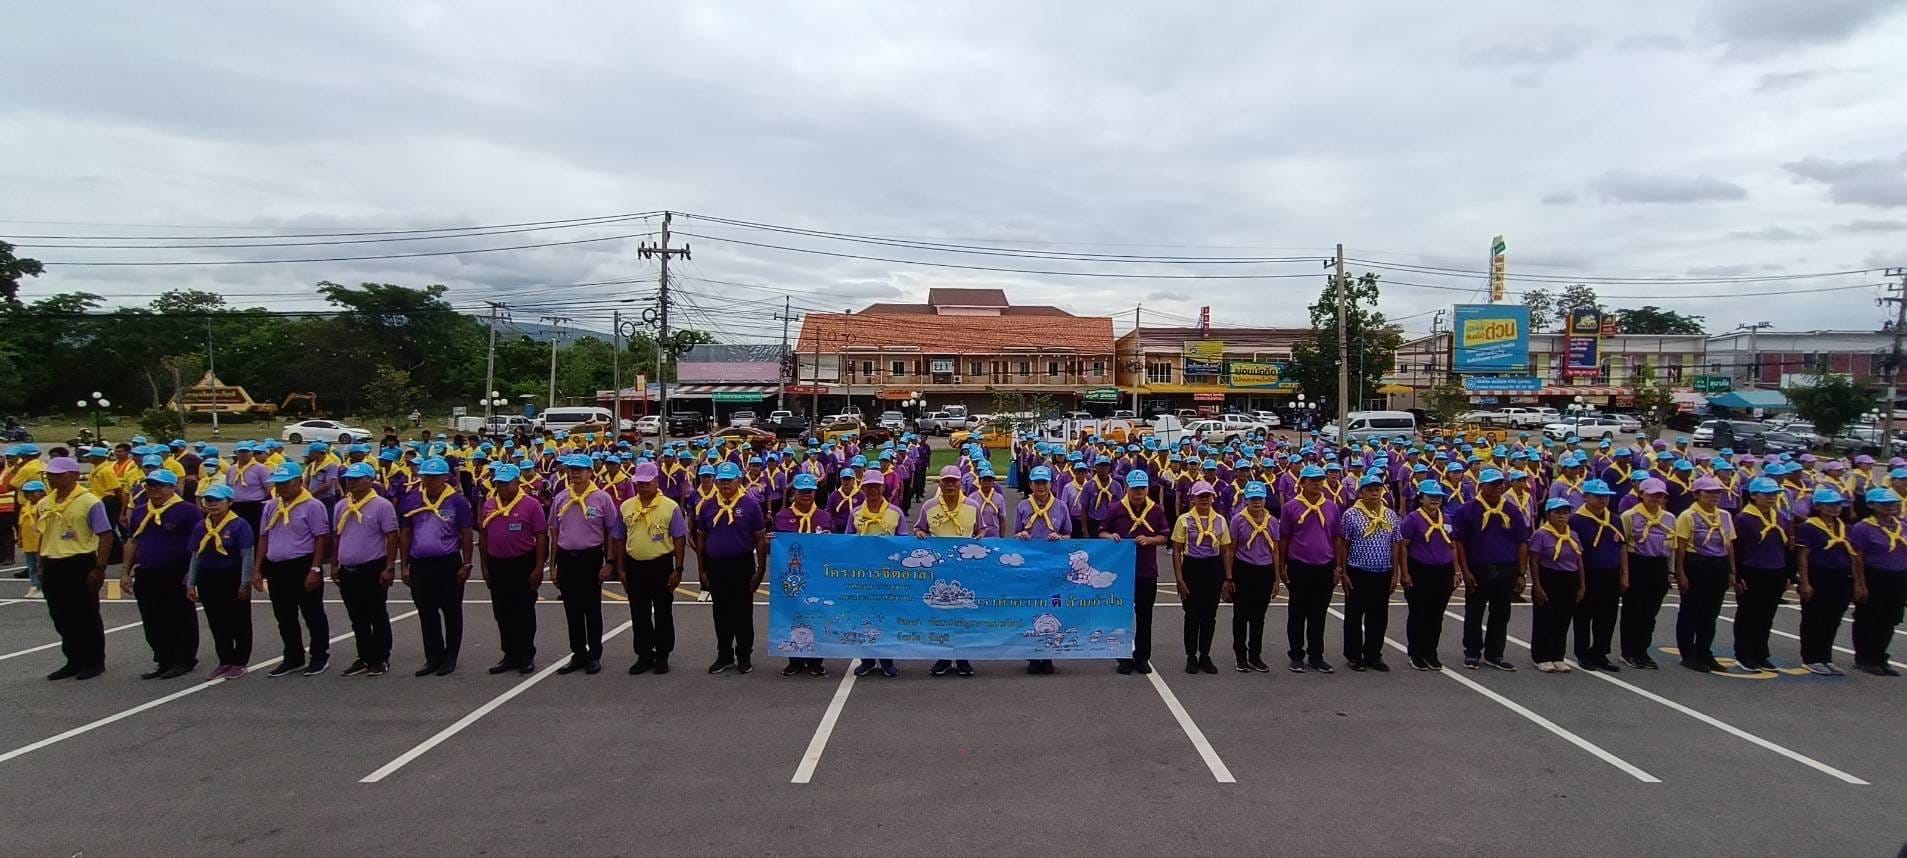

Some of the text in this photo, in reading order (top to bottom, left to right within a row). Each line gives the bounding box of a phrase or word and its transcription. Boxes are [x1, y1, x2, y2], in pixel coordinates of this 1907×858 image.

[823, 563, 935, 580] โครงการจิตอาสา
[1052, 593, 1062, 608] ดี
